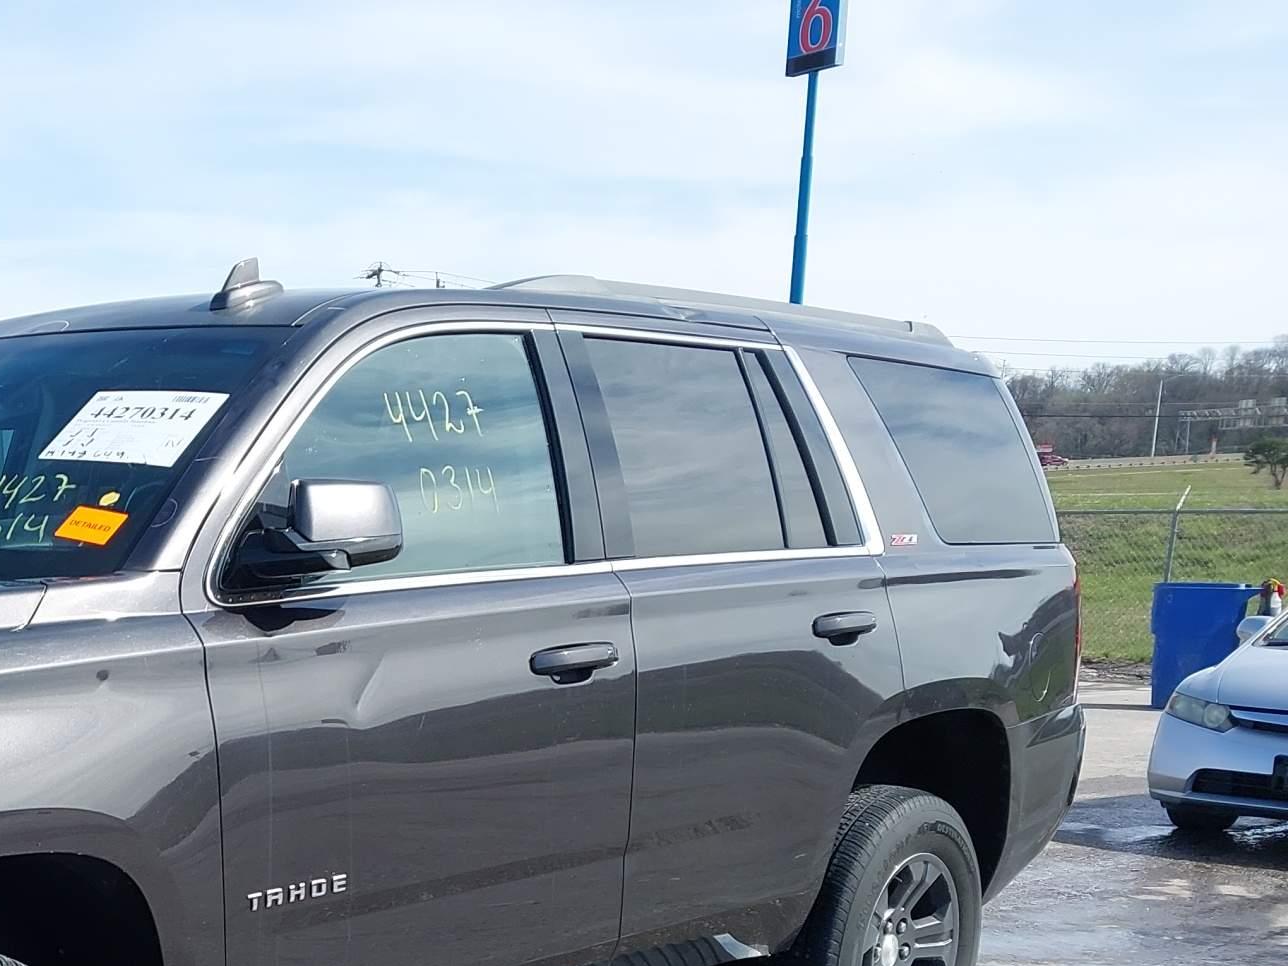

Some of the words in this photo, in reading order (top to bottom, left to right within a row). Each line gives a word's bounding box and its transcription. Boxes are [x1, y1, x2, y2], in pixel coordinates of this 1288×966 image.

[798, 0, 833, 54] 6
[90, 406, 197, 421] 44270314
[384, 389, 484, 442] 4427
[420, 465, 500, 513] 0314
[69, 519, 111, 533] DETAILED
[247, 873, 347, 911] TAHOE
